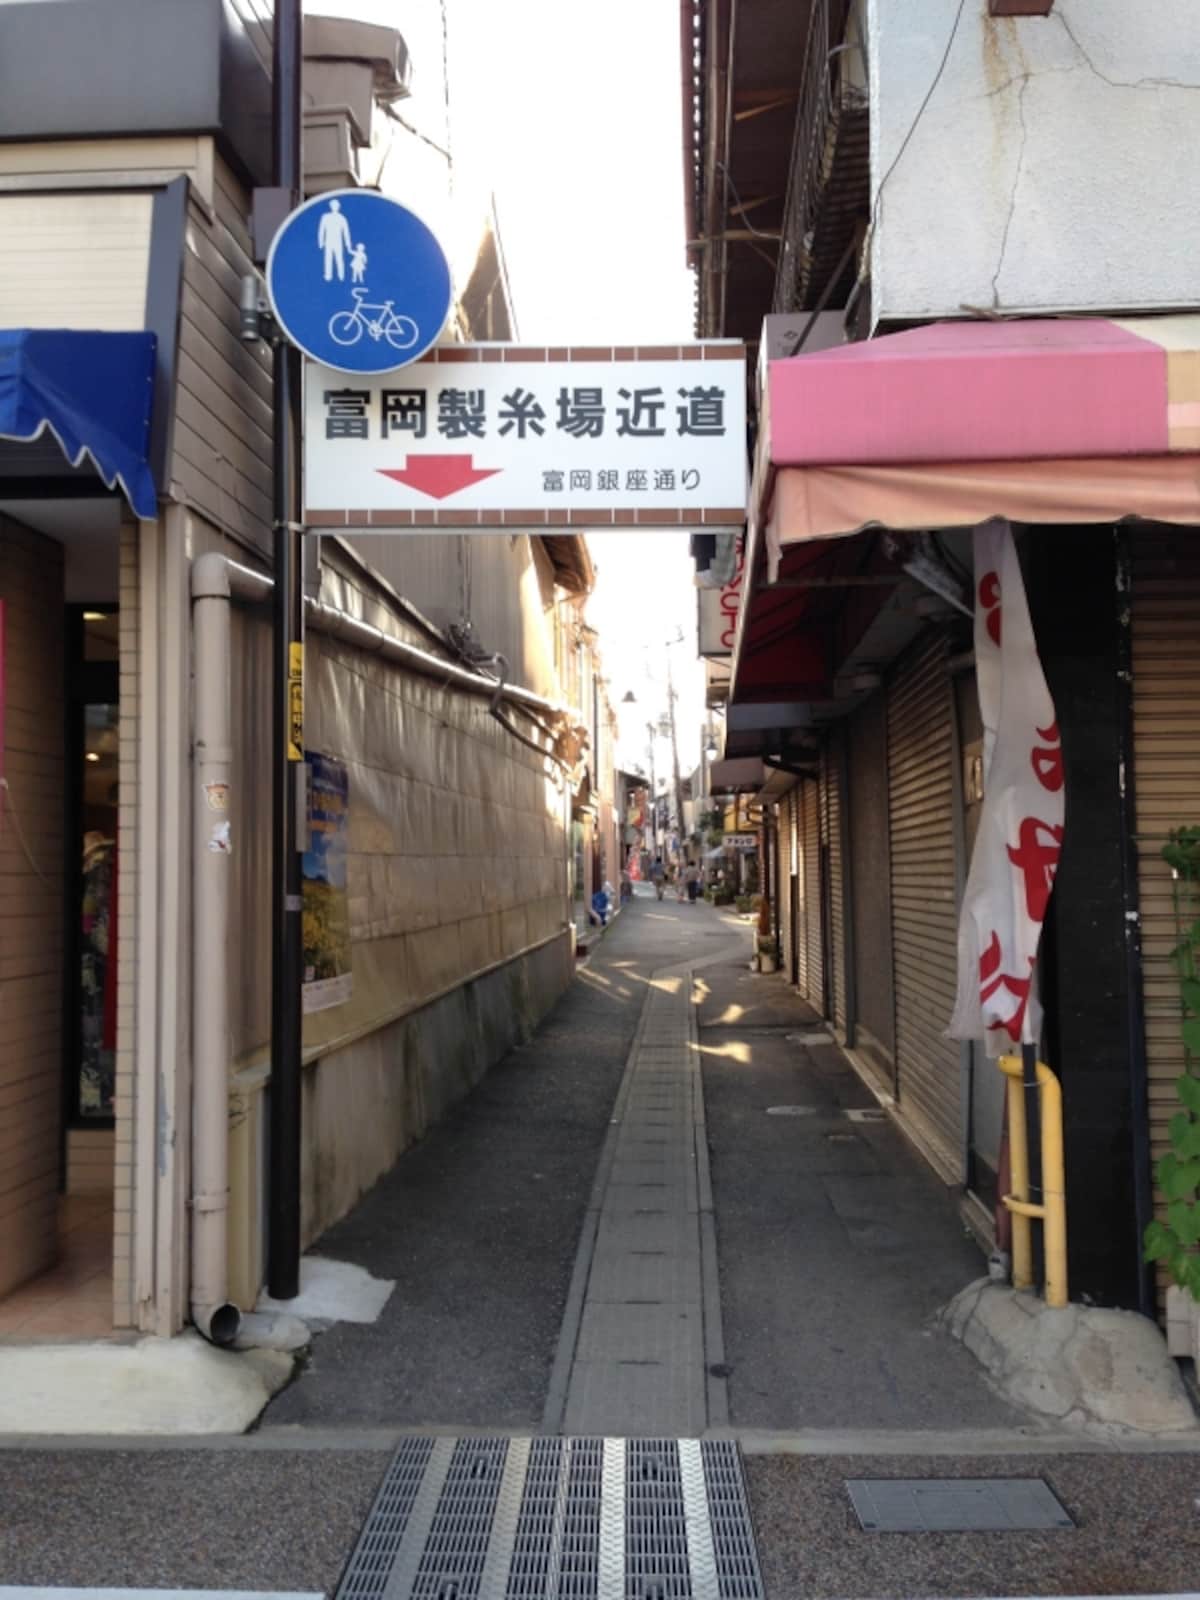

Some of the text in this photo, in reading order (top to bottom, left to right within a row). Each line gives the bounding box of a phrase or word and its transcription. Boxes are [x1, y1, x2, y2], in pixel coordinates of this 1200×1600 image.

[322, 386, 727, 440] 富岡製糸場近道
[541, 468, 701, 492] 富岡銀座通り
